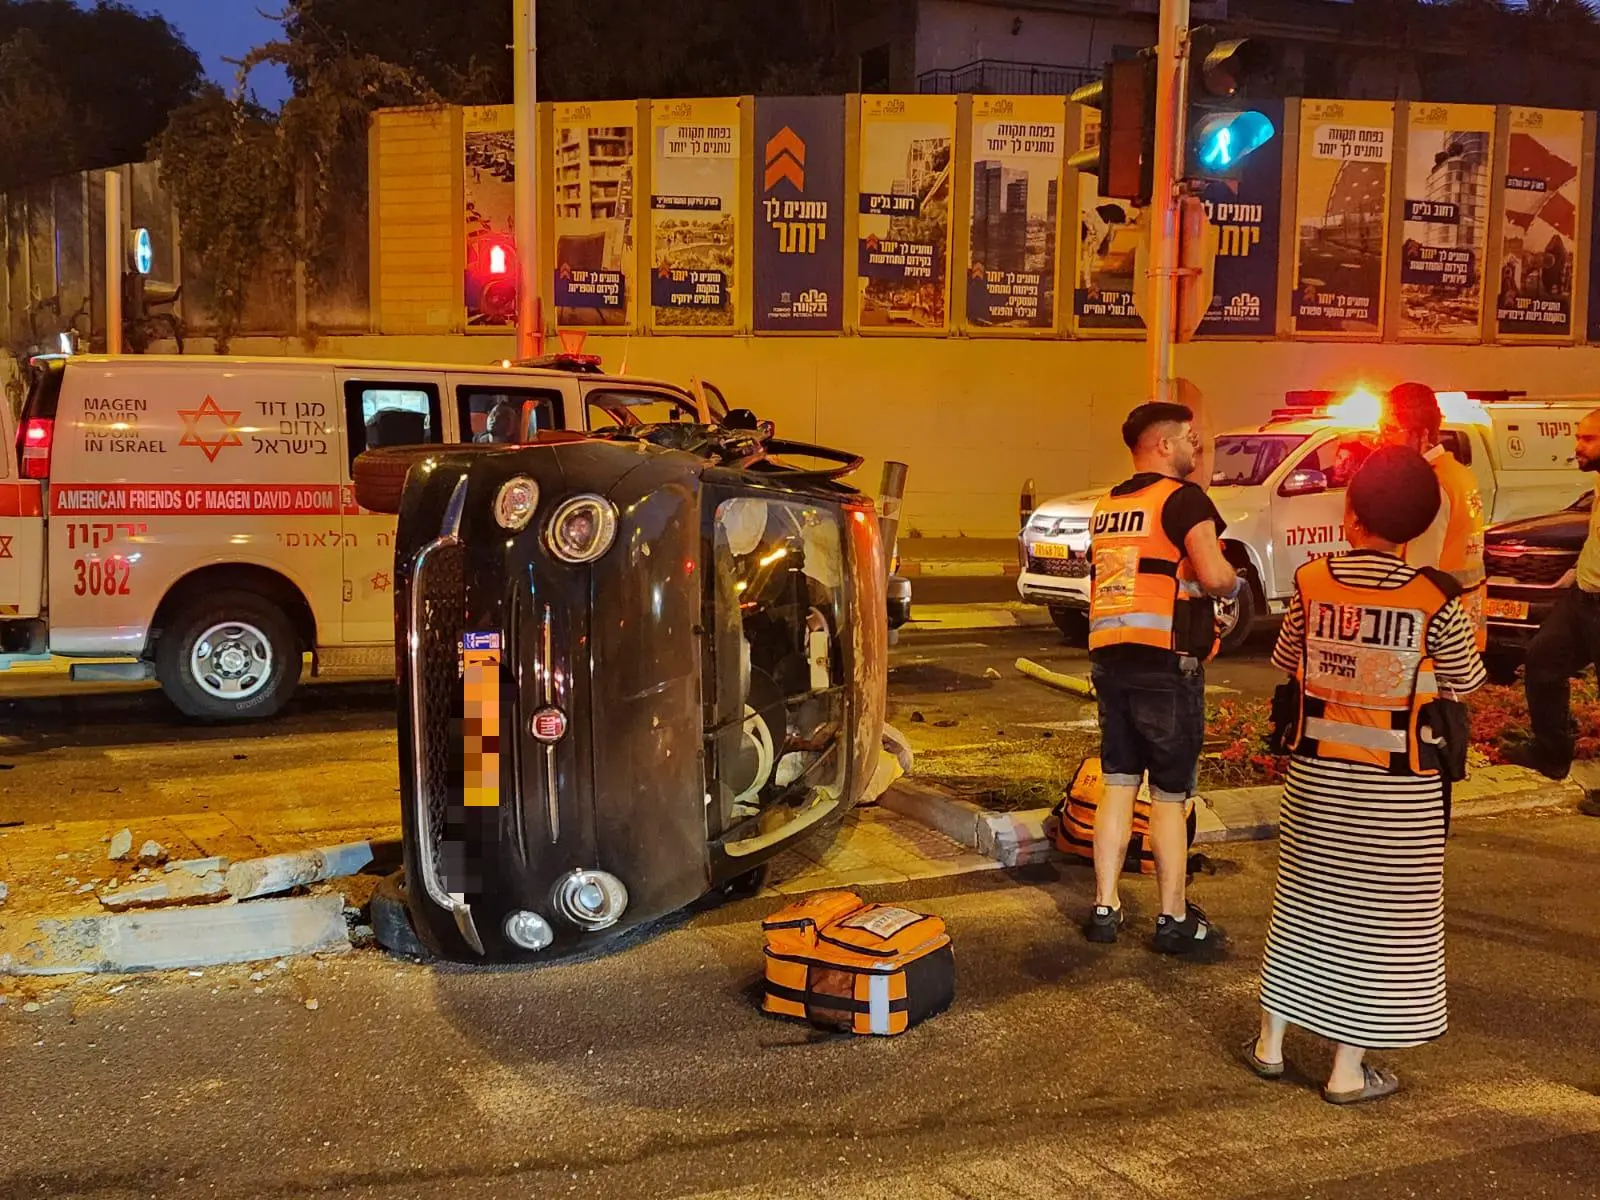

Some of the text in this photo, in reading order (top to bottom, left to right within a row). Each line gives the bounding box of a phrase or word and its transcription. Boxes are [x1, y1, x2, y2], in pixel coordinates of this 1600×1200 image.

[678, 126, 731, 140] בפתח תקווה
[997, 124, 1055, 139] בפתח תקווה
[1328, 128, 1384, 143] בפתח תקווה
[669, 140, 731, 156] נותנים לך יותר
[987, 139, 1055, 154] נותנים לך יותר
[1317, 142, 1383, 158] נותנים לך יותר
[763, 197, 827, 222] נותנים לך
[870, 195, 915, 210] רחוב גליס
[1217, 203, 1262, 223] נותנים
[1433, 205, 1454, 217] רחוב
[772, 222, 826, 253] יותר
[879, 241, 933, 255] נותנים לך יותר
[1419, 248, 1469, 262] נותנים לך יותר
[906, 255, 932, 267] בקידום
[571, 270, 620, 284] נותנים לך יותר
[670, 270, 720, 284] נותנים לך יותר
[985, 271, 1040, 285] נותנים לך יותר
[800, 289, 828, 303] פתח
[1101, 291, 1131, 306] לך יותר
[1231, 292, 1260, 306] פתח
[1316, 293, 1370, 307] נותנים לך יותר
[792, 302, 828, 314] תקווה
[1083, 303, 1106, 315] החיים
[1223, 305, 1260, 317] תקווה
[84, 398, 147, 411] MAGEN
[255, 401, 326, 420] מגן דוד
[279, 420, 328, 436] אדום
[1536, 421, 1572, 439] פיקוד
[85, 439, 168, 453] IN ISRAEL
[251, 435, 328, 455] בישראל
[57, 490, 333, 509] AMERICAN FRIENDS OF MAGEN DAVID ADOM
[1093, 510, 1145, 535] חובש
[66, 523, 148, 549] ירקון
[276, 530, 358, 547] הלאומי
[1286, 525, 1333, 546] והצלה
[73, 558, 131, 596] 3082
[1316, 602, 1416, 648] חובשת
[475, 634, 491, 649] IL
[1319, 650, 1357, 666] איחוד
[1319, 662, 1356, 678] הצלה
[540, 716, 557, 737] FIAT
